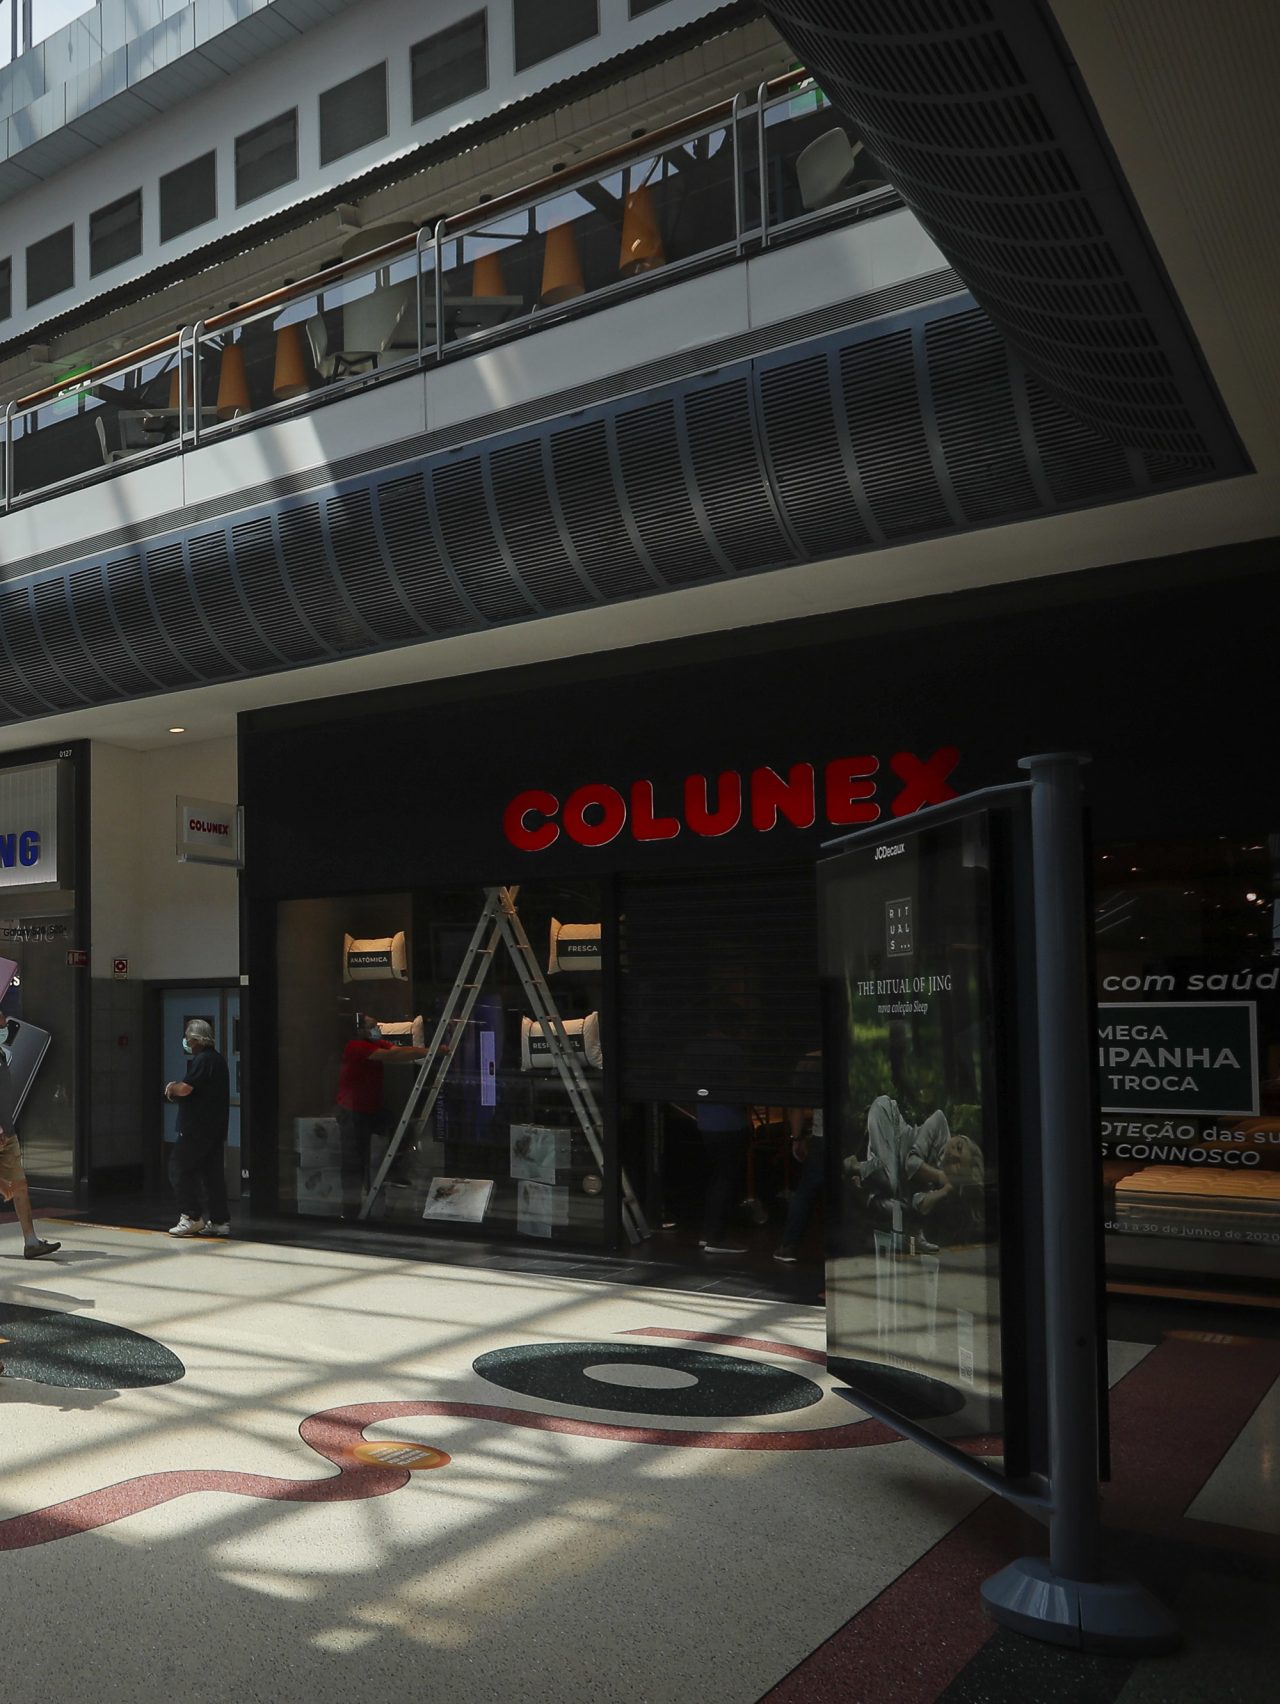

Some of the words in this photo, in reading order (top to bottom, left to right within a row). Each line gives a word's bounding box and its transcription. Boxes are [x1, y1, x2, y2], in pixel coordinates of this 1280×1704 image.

[503, 745, 960, 851] COLUNEX
[189, 819, 229, 835] COLUNEX
[874, 842, 906, 861] JCDecaux
[568, 944, 598, 952] FRESCA
[857, 980, 875, 996] THE
[877, 977, 911, 995] RITUAL
[913, 976, 926, 993] OF
[928, 974, 952, 996] JING
[1102, 974, 1176, 992] com
[1098, 1024, 1168, 1041] MEGA
[1107, 1074, 1199, 1092] TROCA
[1202, 1126, 1246, 1143] das
[1115, 1143, 1261, 1165] CONNOSCO
[1104, 1220, 1119, 1230] de
[1143, 1223, 1158, 1232] 30
[1162, 1225, 1178, 1234] de
[1181, 1224, 1220, 1238] junho
[1224, 1230, 1241, 1240] de
[1245, 1231, 1280, 1242] 2020
